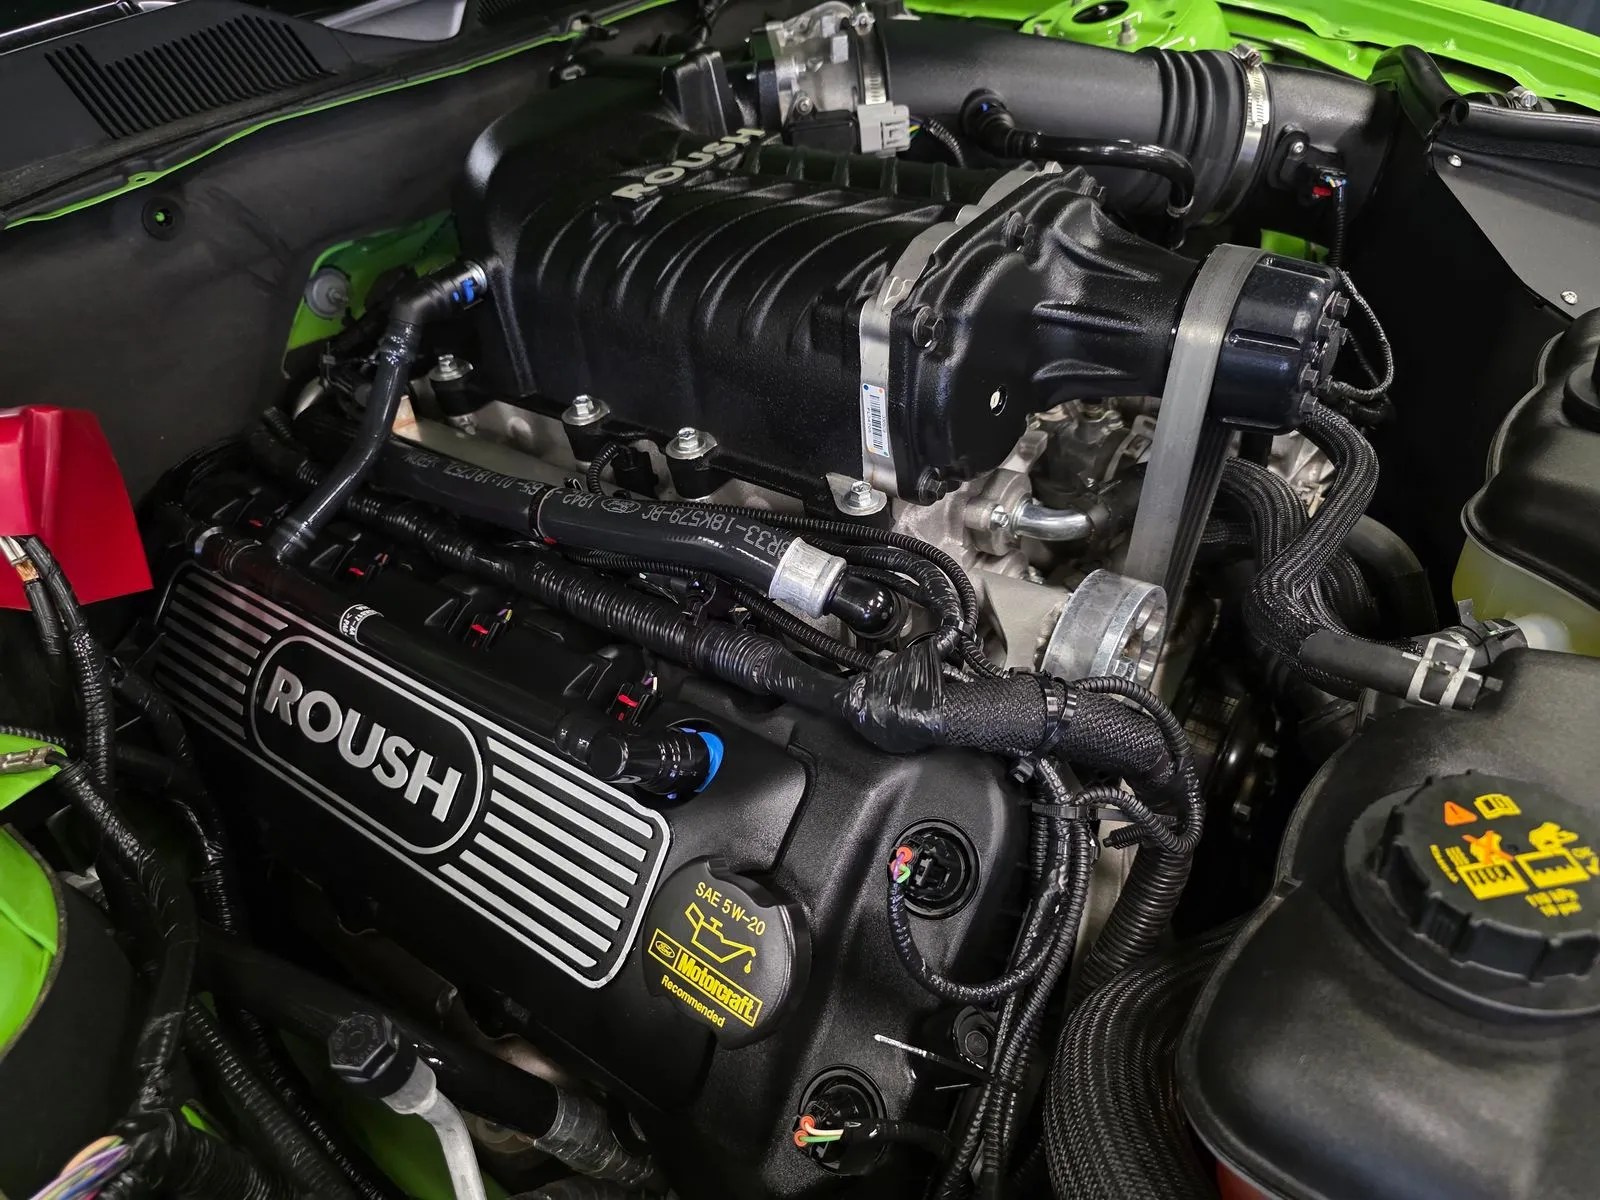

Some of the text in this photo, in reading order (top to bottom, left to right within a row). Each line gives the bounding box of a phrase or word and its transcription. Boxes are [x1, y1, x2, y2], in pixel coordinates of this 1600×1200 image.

[611, 128, 765, 199] ROUSH
[263, 665, 462, 823] ROUSH
[695, 882, 766, 936] SAE 5W-20
[656, 941, 755, 1020] Ford Motorcraft
[661, 974, 726, 1028] Recommended
